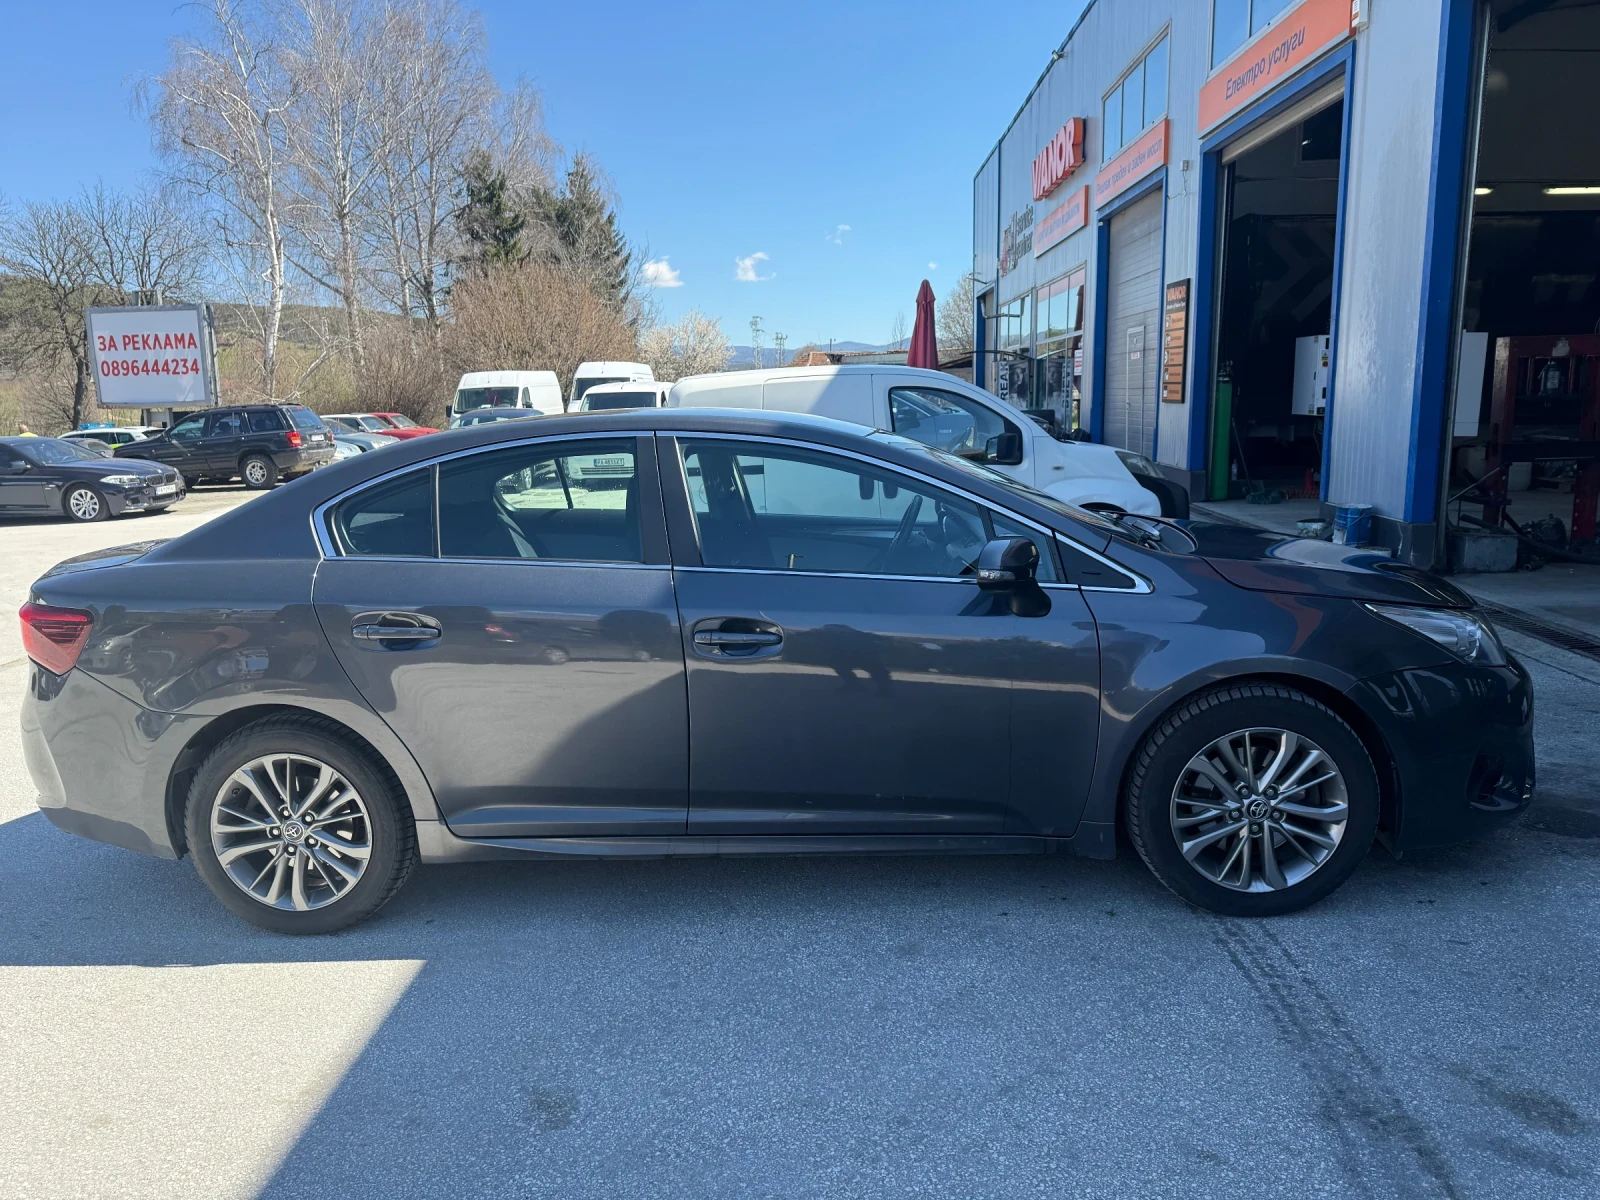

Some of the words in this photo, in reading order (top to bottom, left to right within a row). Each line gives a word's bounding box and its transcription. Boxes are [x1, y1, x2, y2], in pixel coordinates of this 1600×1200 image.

[1225, 57, 1266, 100] Електро
[1267, 26, 1306, 75] услуги
[1032, 117, 1079, 202] VIANOR
[97, 335, 118, 351] ЗА
[122, 332, 198, 351] РЕКЛАМА
[101, 358, 200, 377] 0896444234
